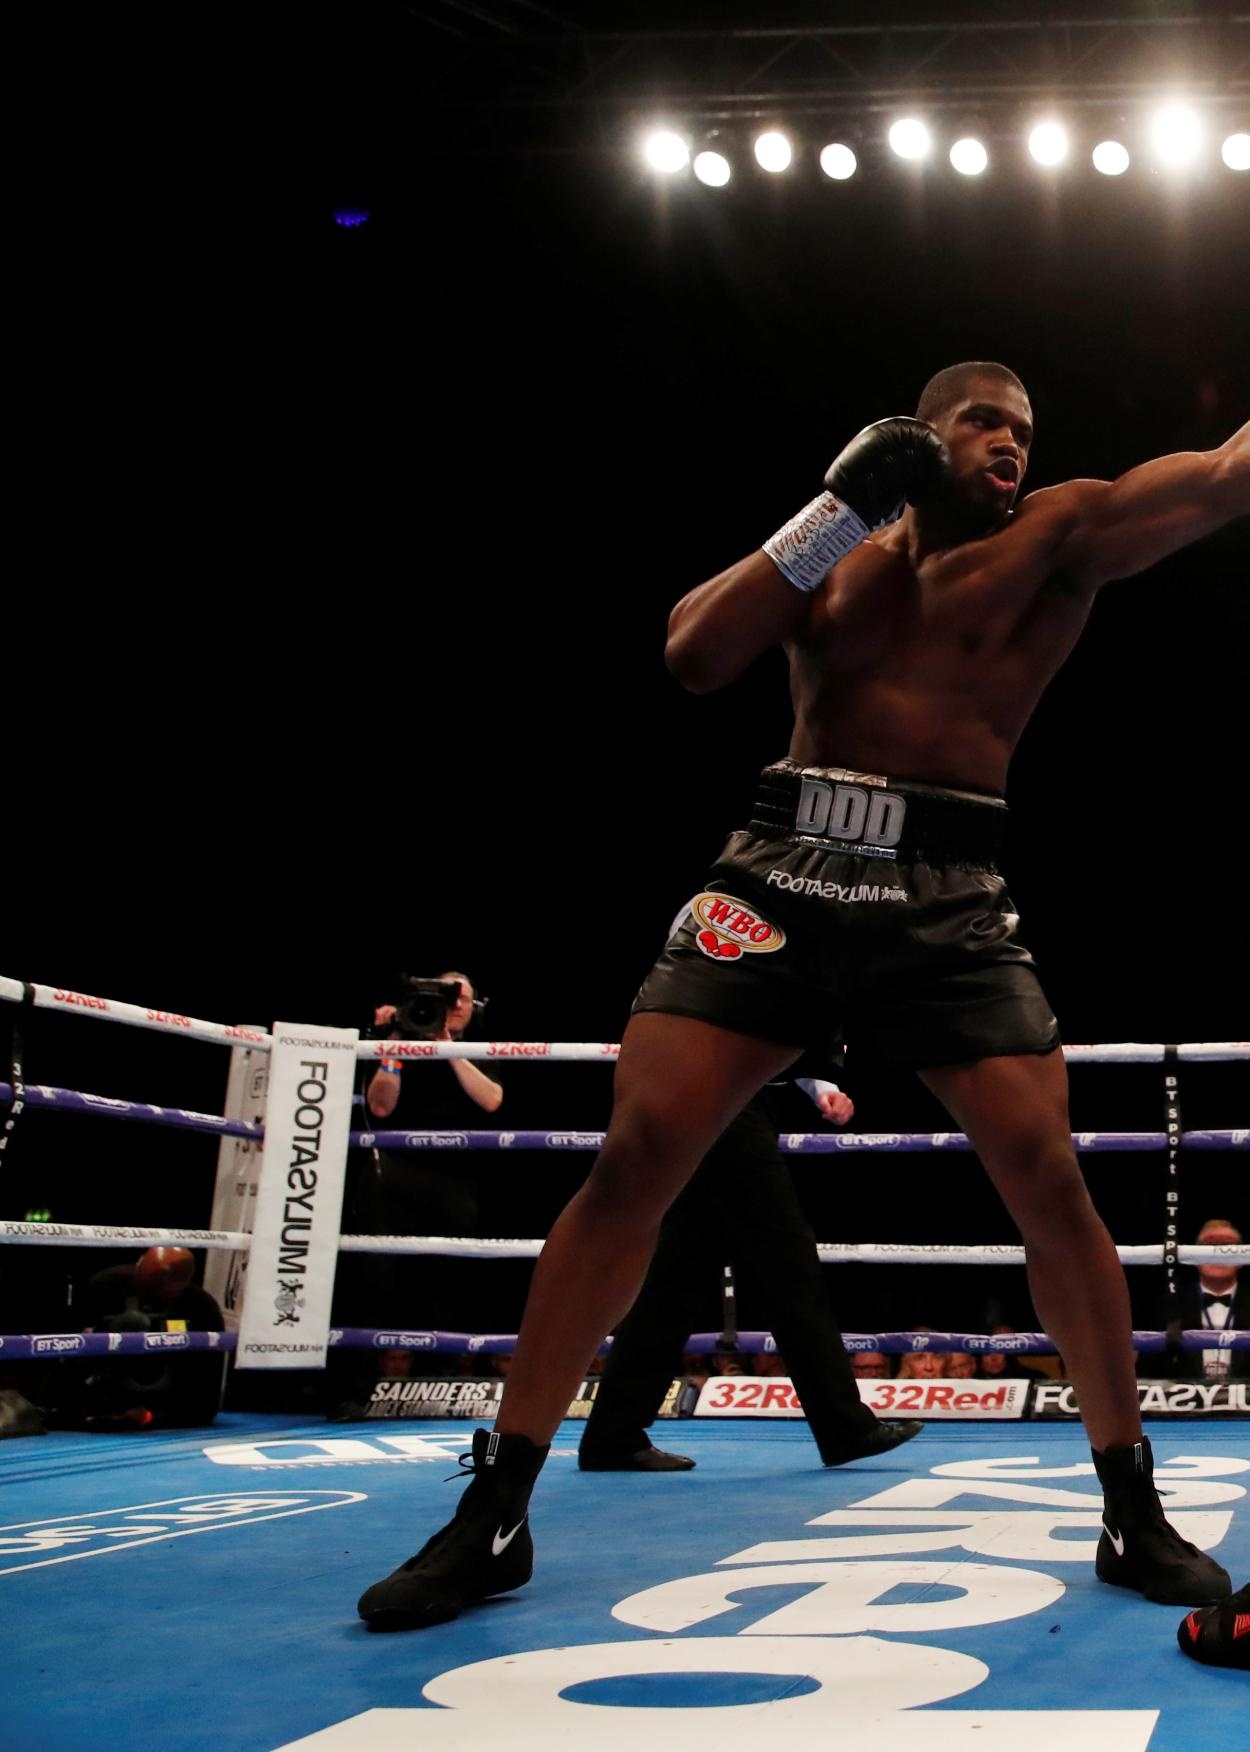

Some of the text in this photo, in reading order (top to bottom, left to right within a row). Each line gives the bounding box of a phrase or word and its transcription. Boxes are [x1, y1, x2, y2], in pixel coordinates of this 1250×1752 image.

[796, 779, 906, 847] DDD
[766, 869, 880, 902] FOOTASYLUM
[706, 898, 773, 943] WBO
[277, 1060, 329, 1275] FOOTASYLUM
[370, 1382, 492, 1402] SAUNDERS
[870, 1384, 1007, 1411] 32Red
